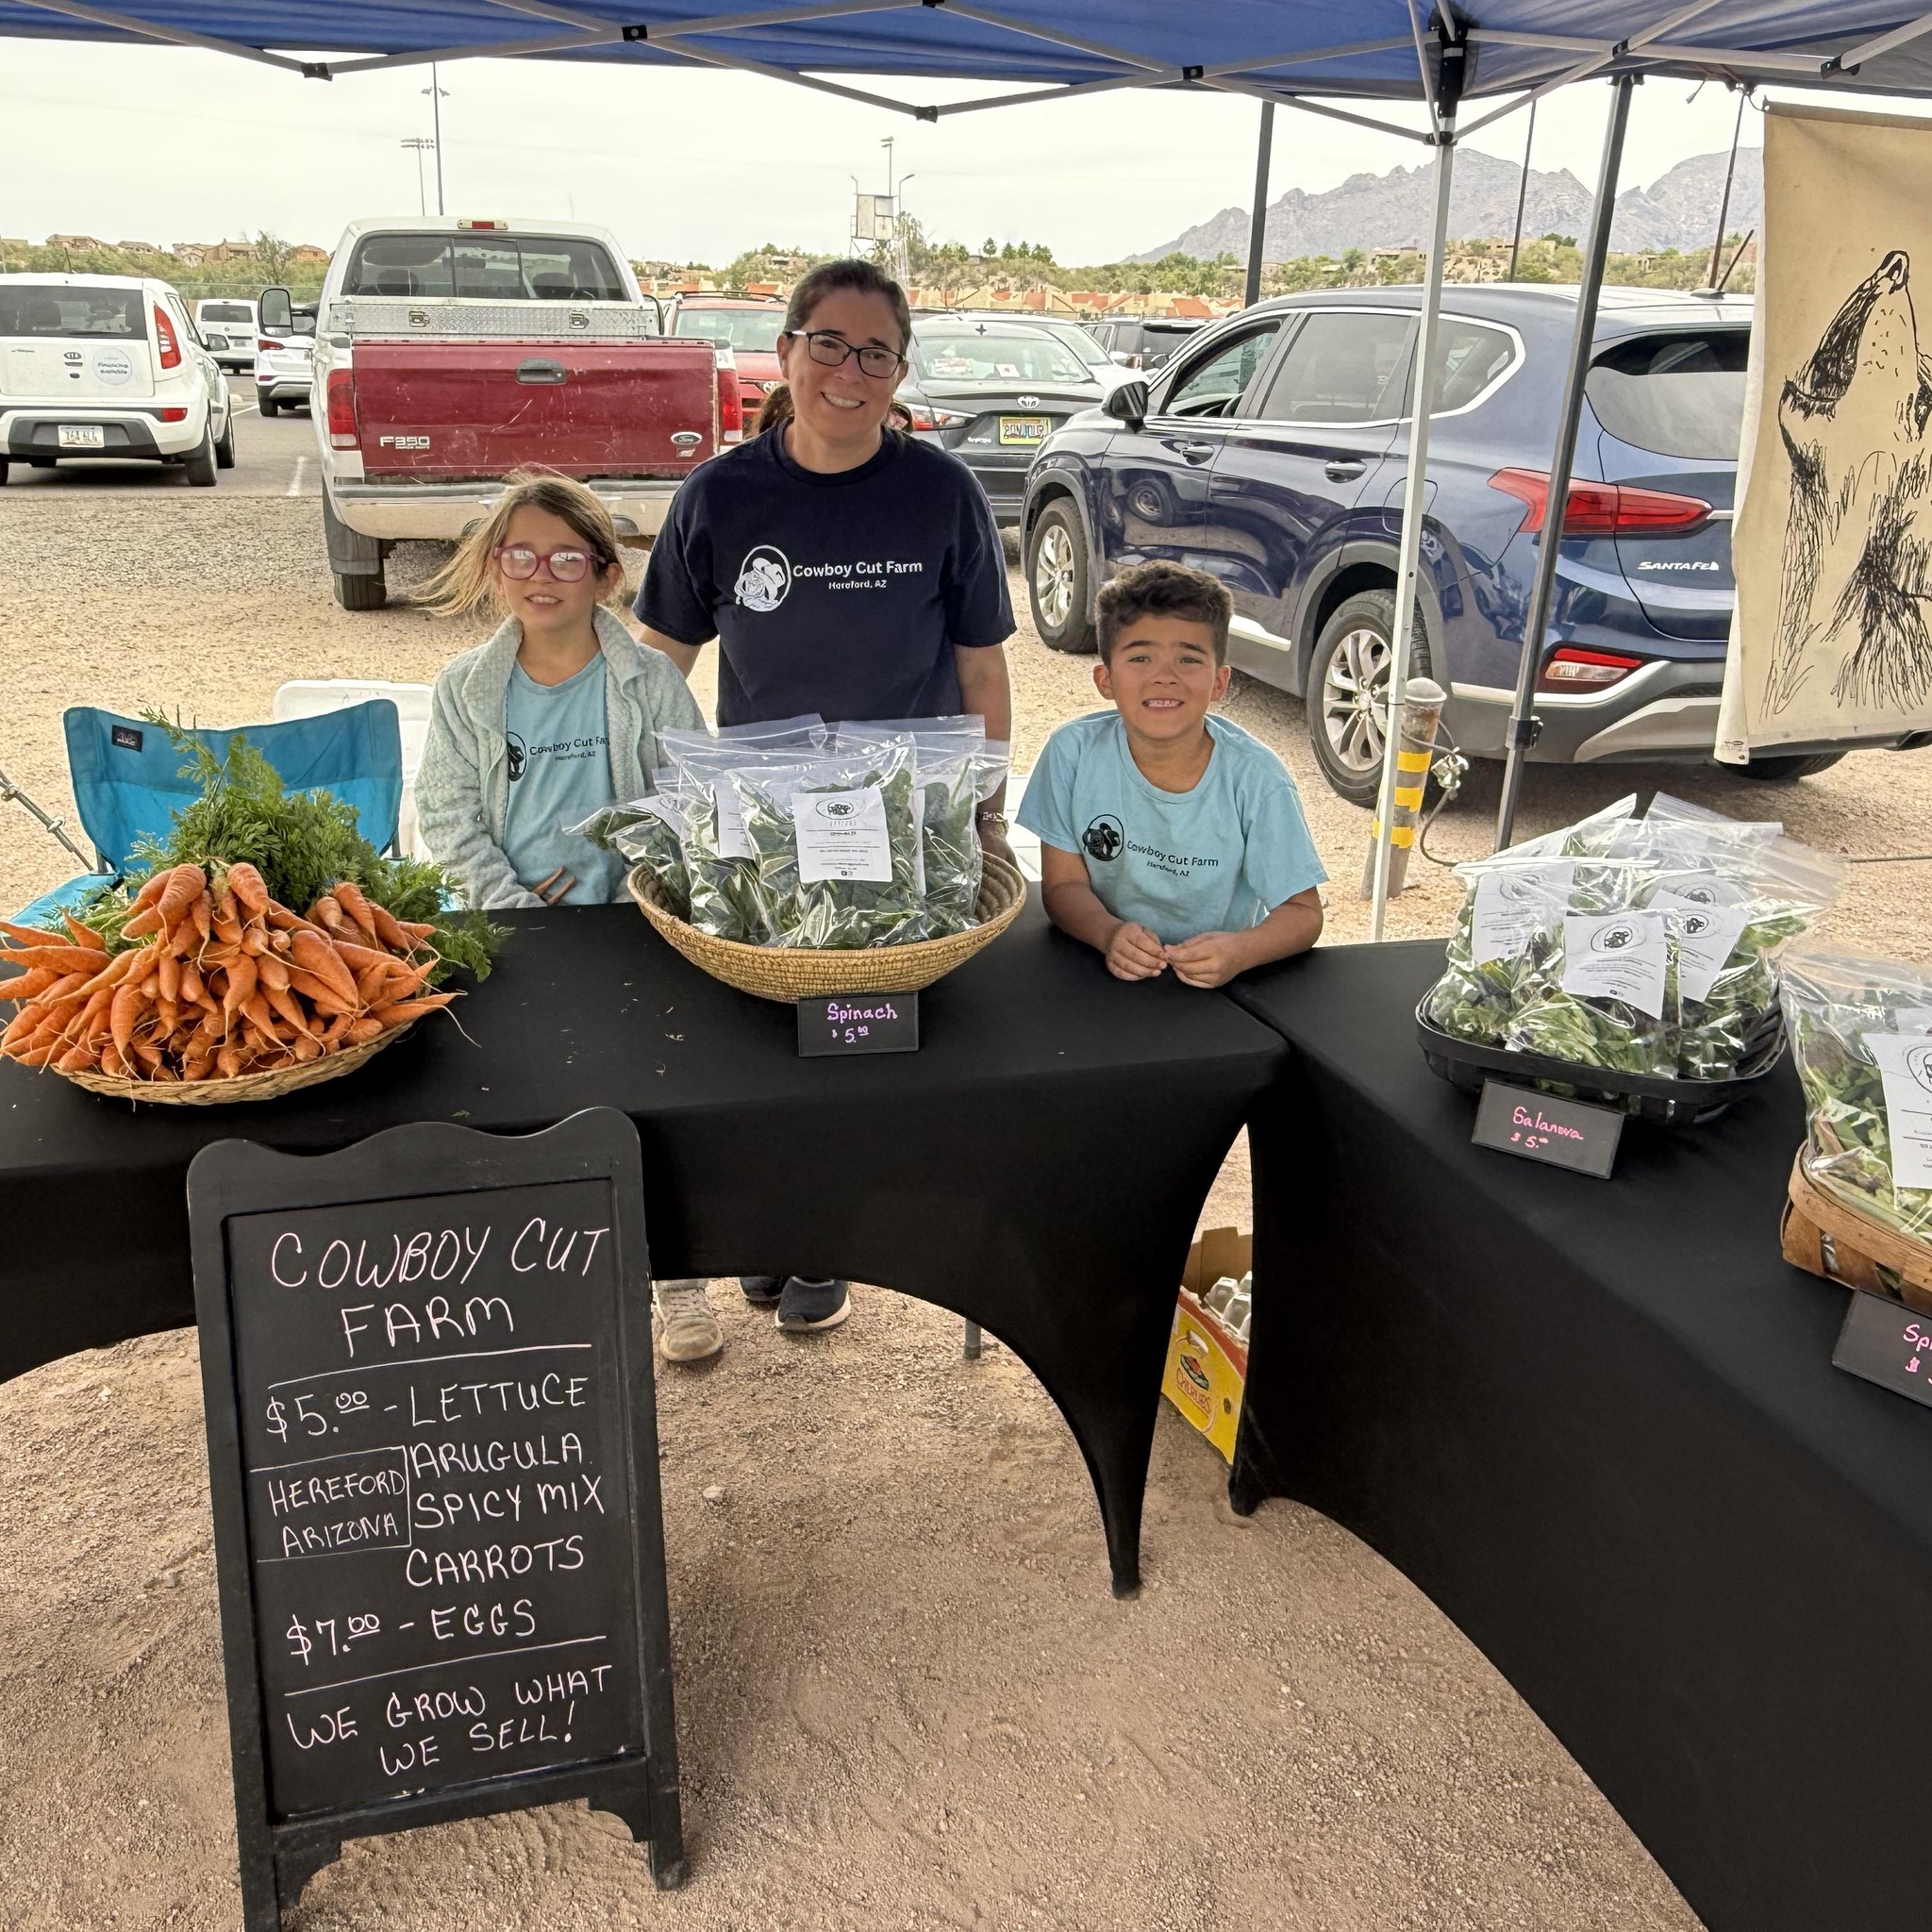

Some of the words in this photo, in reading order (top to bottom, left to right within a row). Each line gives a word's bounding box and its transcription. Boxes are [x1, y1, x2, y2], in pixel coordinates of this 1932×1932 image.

[380, 436, 430, 446] F350
[792, 563, 852, 577] Cowboy
[856, 561, 883, 575] Cut
[886, 560, 923, 574] Farm
[874, 579, 887, 588] AZ
[529, 741, 572, 756] Cowboy
[574, 738, 592, 747] Cut
[1127, 841, 1166, 862] Cowboy
[1168, 855, 1189, 866] Cut
[1191, 857, 1219, 867] Farm
[827, 1002, 898, 1024] Spinach
[272, 1226, 491, 1288] COWBOY
[511, 1218, 609, 1276] CUT
[341, 1295, 515, 1357] FARM
[410, 1374, 588, 1426] LETTUCE
[409, 1432, 583, 1479] ARUGULA
[269, 1470, 405, 1516] HEREFORD
[415, 1485, 521, 1528] SPICY
[537, 1474, 604, 1514] MIX
[282, 1512, 400, 1557] ARIZONA
[406, 1534, 586, 1587] CARROTS
[431, 1599, 535, 1640] EGGS
[287, 1707, 358, 1749] WE
[386, 1686, 487, 1728] GROW
[515, 1664, 613, 1705] WHAT
[380, 1736, 440, 1775] WE
[469, 1701, 575, 1753] SELL!
